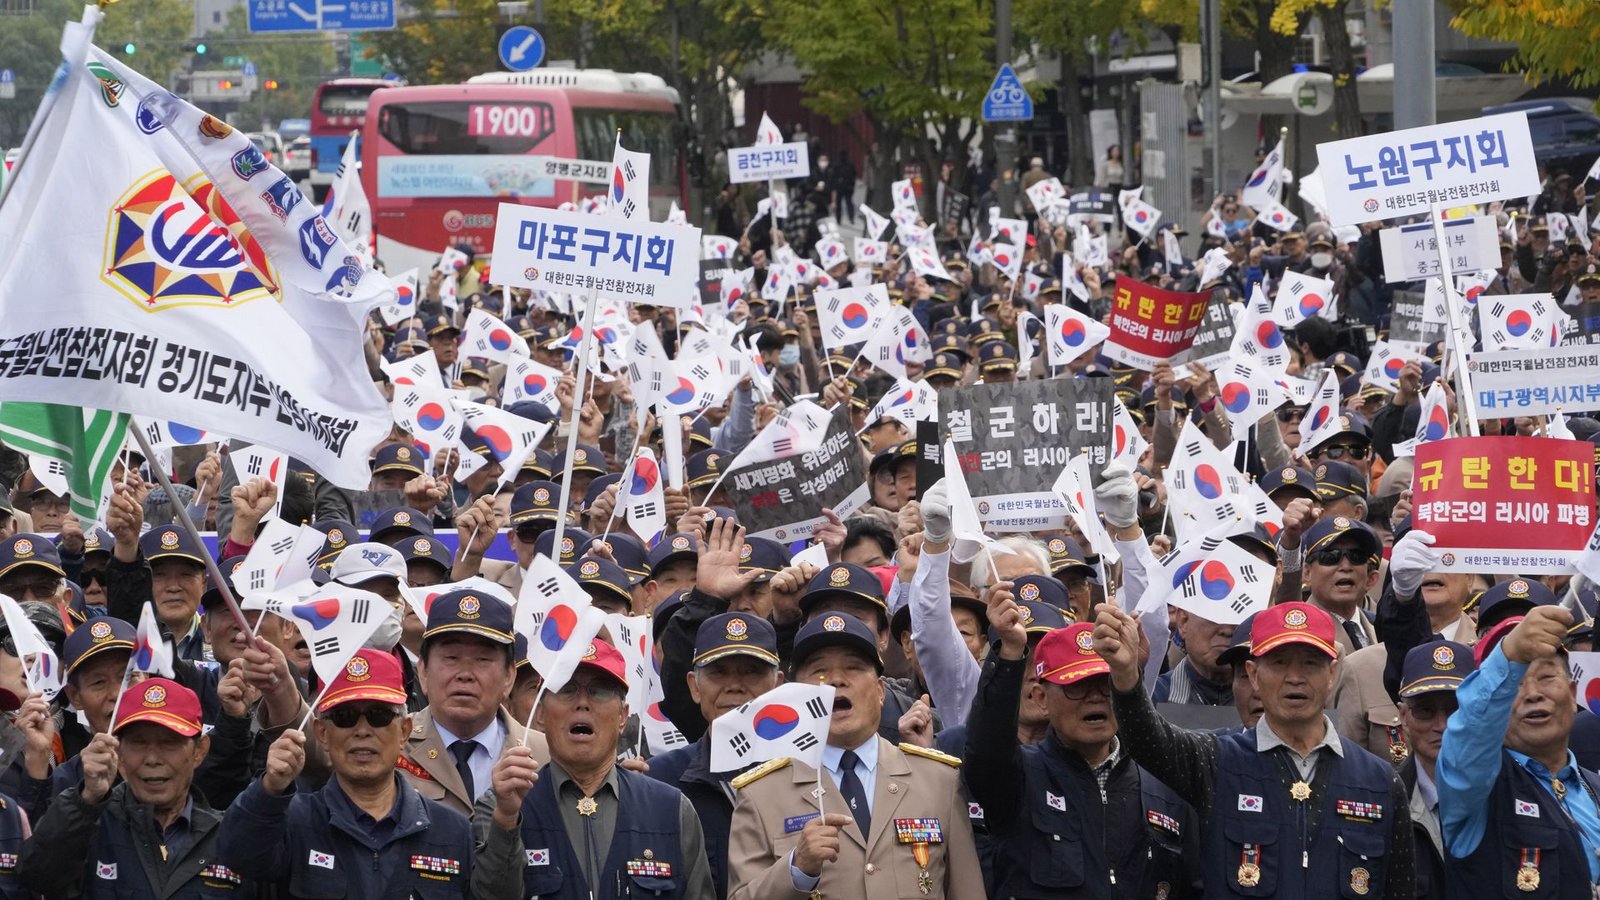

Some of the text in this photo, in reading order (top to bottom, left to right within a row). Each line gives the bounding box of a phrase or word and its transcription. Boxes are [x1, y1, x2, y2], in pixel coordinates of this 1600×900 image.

[474, 106, 536, 136] 1900
[737, 149, 798, 170] 금천구지회
[1344, 130, 1510, 191] 노원구지회
[1385, 180, 1501, 210] 대한민국월남전참전자회
[518, 220, 675, 276] 마포구지회
[1413, 234, 1467, 251] 서울부
[1417, 256, 1469, 273] 중구회
[545, 271, 656, 297] 대한민국월남전참전자회
[1112, 314, 1149, 339] 북한군의
[1151, 328, 1183, 345] 러시아
[1479, 354, 1598, 374] 대한민국월남전참전자회
[157, 342, 272, 417] 경기도지부
[1479, 383, 1600, 408] 대구광역시지부
[733, 430, 851, 491] 세계평화 위협하는
[1023, 447, 1070, 467] 러시아
[800, 457, 850, 497] 각성하라!
[1417, 501, 1590, 527] 북한군의 러시아 파병
[1464, 556, 1567, 567] 대한민국월남전참전자회
